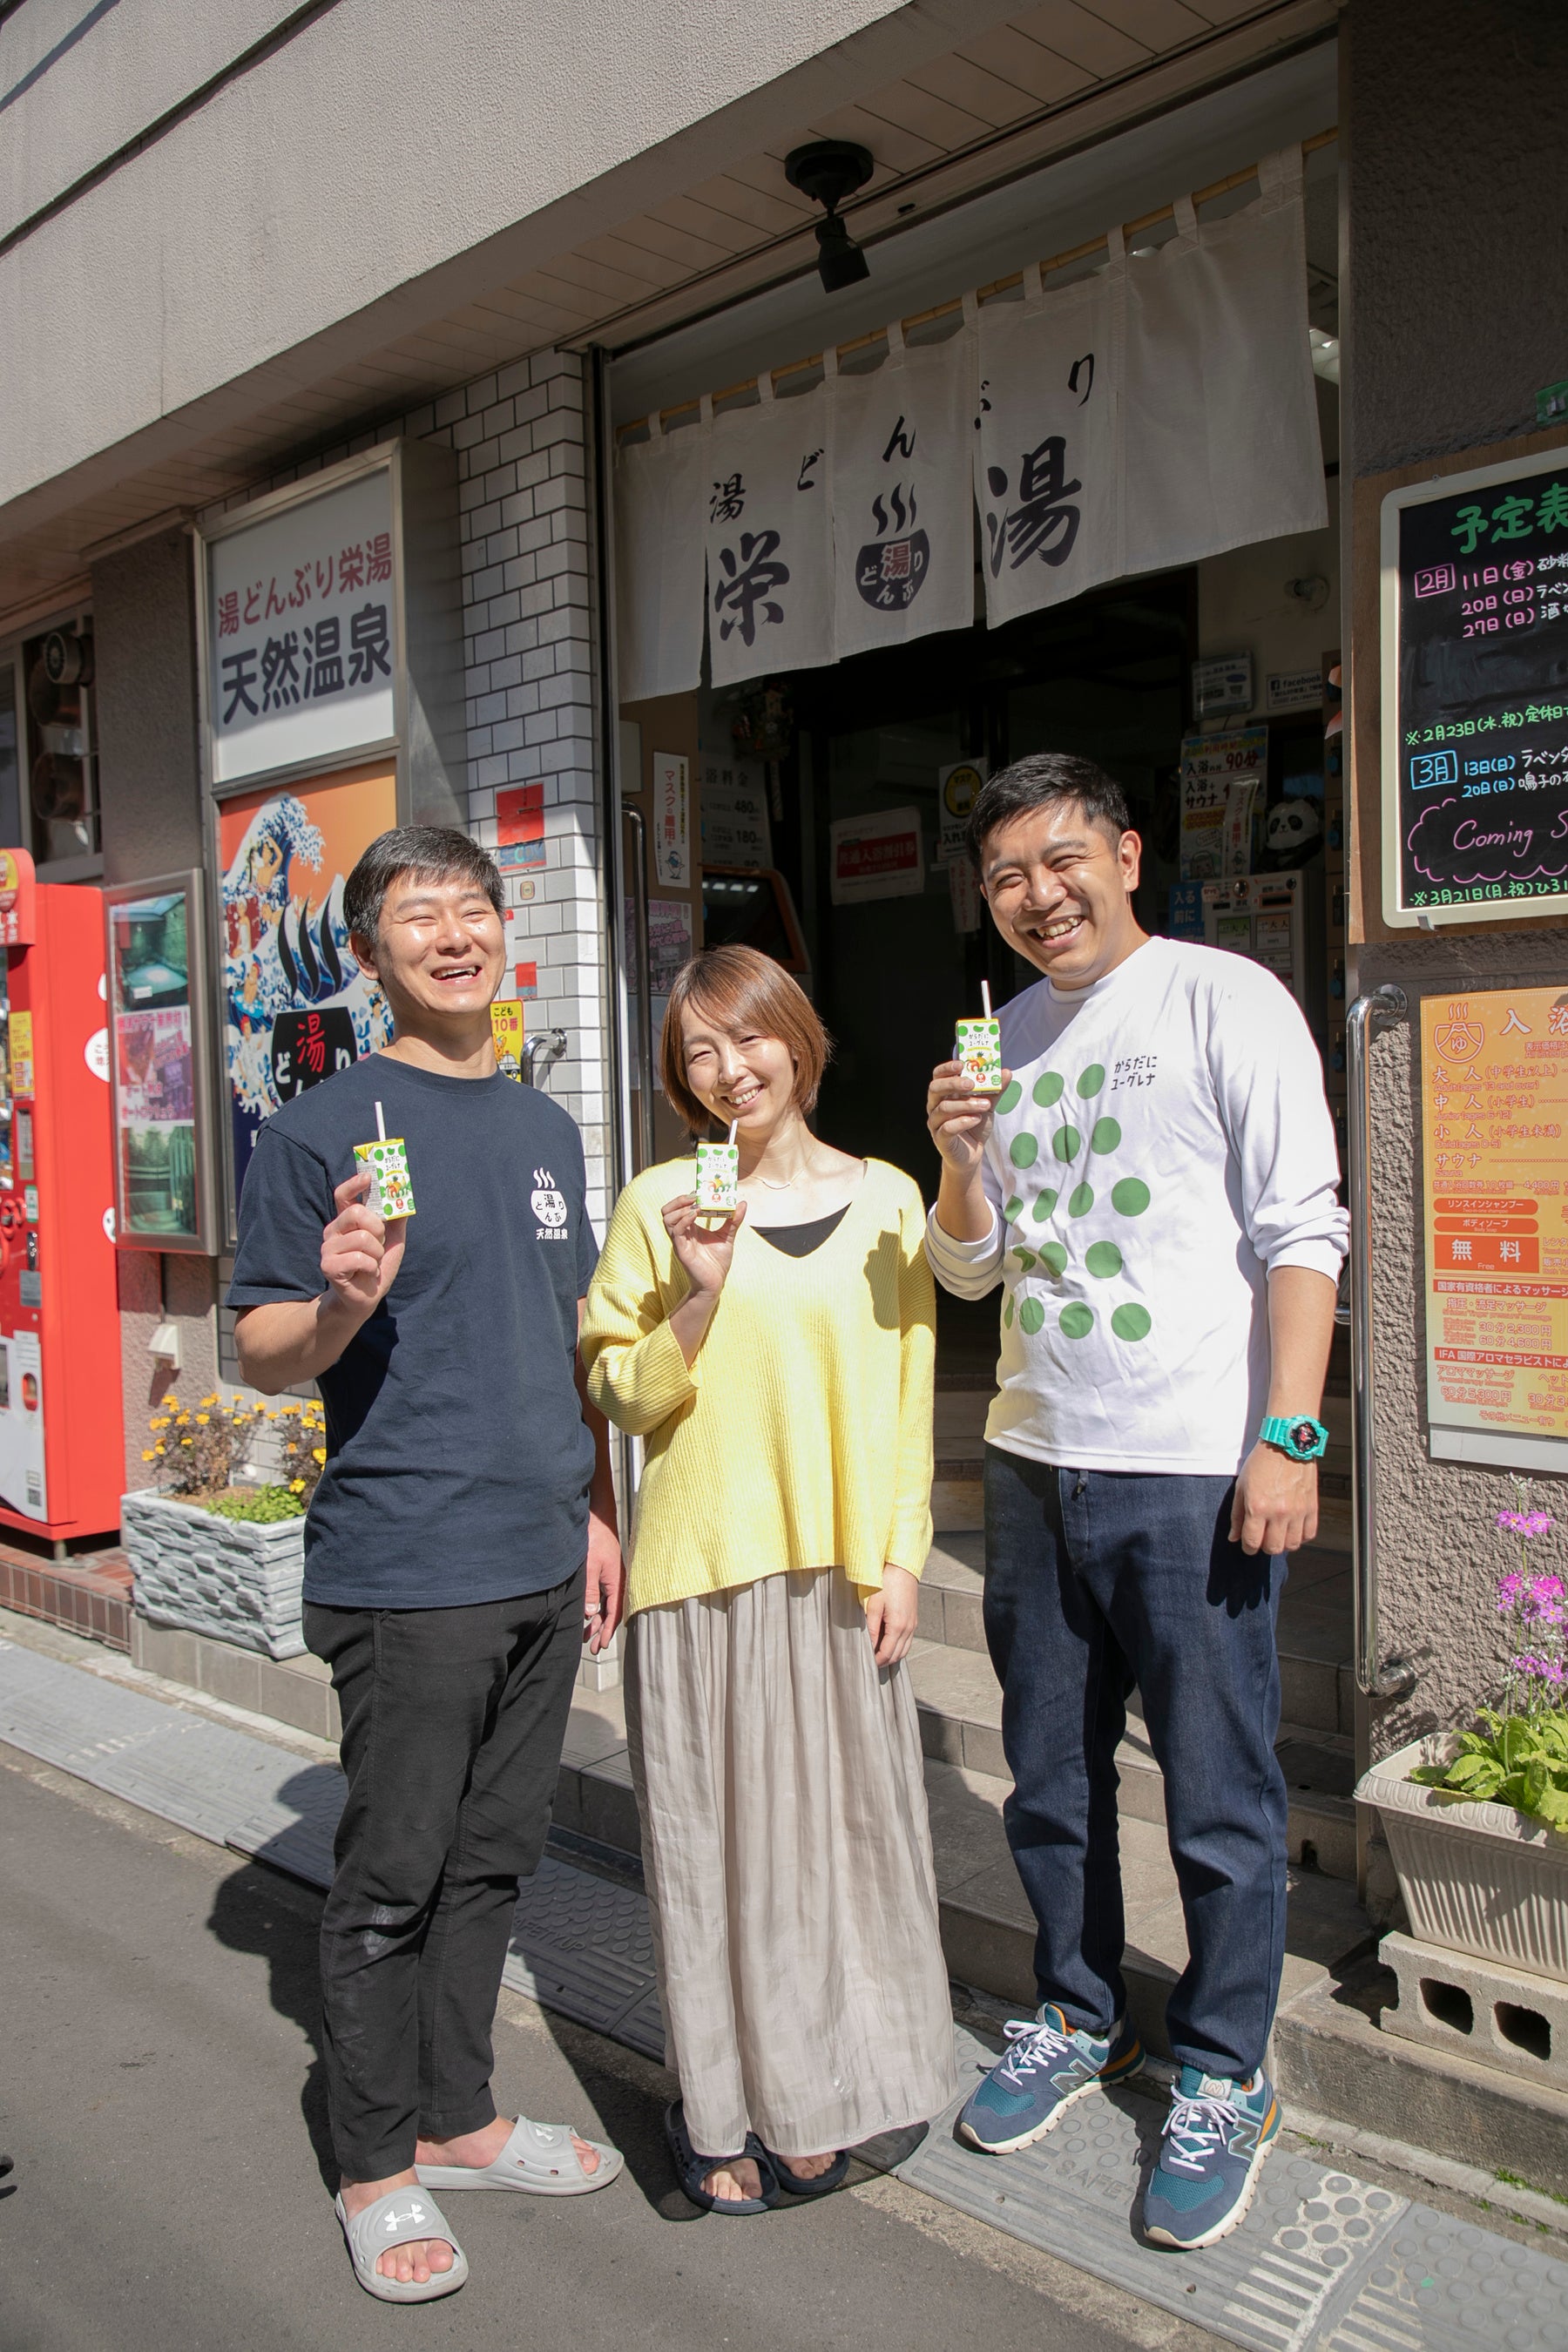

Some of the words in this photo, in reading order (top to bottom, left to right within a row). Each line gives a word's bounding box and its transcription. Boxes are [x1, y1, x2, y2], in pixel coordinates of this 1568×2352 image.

[1450, 483, 1568, 554] 予定表
[883, 542, 909, 578] 湯
[218, 532, 392, 639] 湯どんぶり栄湯
[1420, 568, 1449, 591] 2月
[1461, 586, 1534, 616] 20日(日)
[1462, 607, 1534, 638] 27日(日)
[221, 602, 392, 726] 天然温泉
[1282, 674, 1321, 687] facebook
[1226, 750, 1258, 769] 90分
[1420, 756, 1450, 783] 3月
[1463, 754, 1516, 776] 13日(日)
[1462, 777, 1516, 798] 20日(日)
[1186, 794, 1218, 809] サウナ
[1454, 820, 1534, 858] Coming
[494, 1007, 515, 1017] こども
[492, 1018, 519, 1032] 10番
[297, 1013, 326, 1073] 湯
[1451, 1036, 1468, 1054] ゆ
[1525, 1041, 1568, 1051] 表示価格は
[1113, 1055, 1158, 1074] からだに
[1111, 1072, 1156, 1091] ユーグレナ
[1436, 1152, 1482, 1169] サウナ
[1447, 1200, 1524, 1210] リンスインシャンプー
[1463, 1219, 1510, 1228] ボディソープ
[536, 1227, 569, 1241] 天然温泉
[1451, 1238, 1522, 1263] 無料
[1477, 1262, 1495, 1271] Free
[1439, 1349, 1456, 1360] IFA
[1436, 1365, 1515, 1382] アロママッサージ
[1479, 1409, 1556, 1428] その他メニュー有り
[515, 1916, 587, 1953] AFETY.UP
